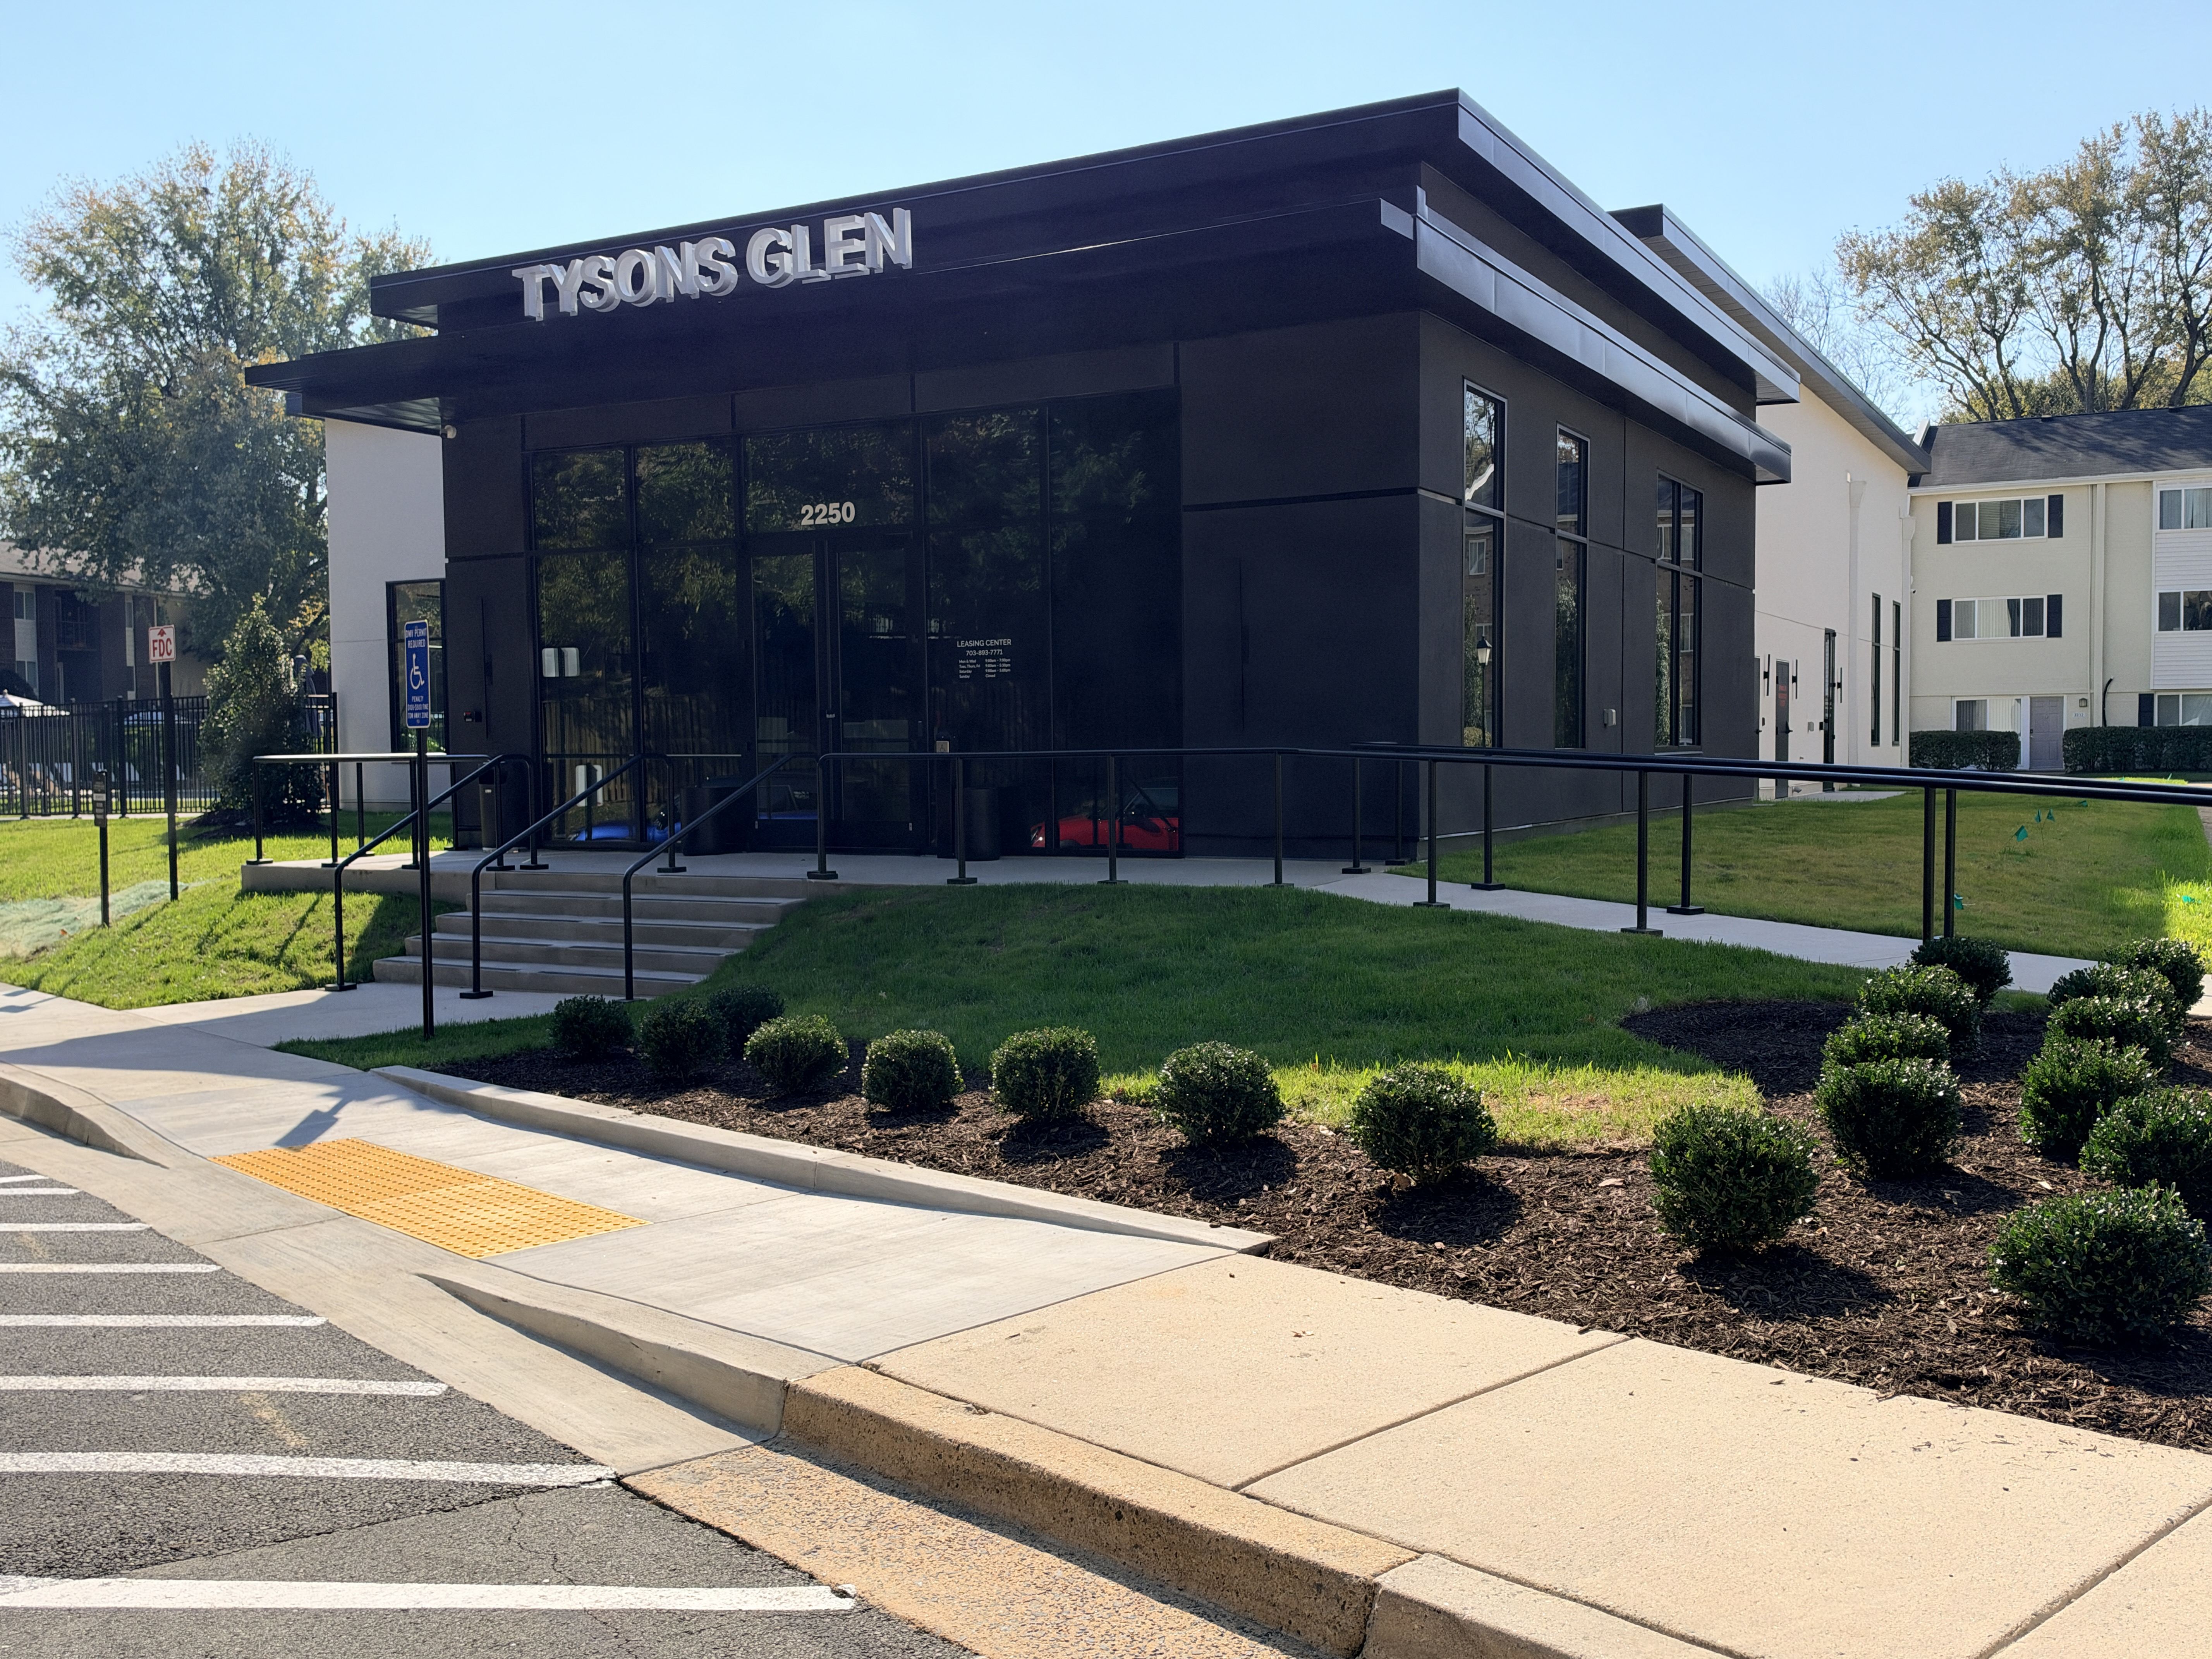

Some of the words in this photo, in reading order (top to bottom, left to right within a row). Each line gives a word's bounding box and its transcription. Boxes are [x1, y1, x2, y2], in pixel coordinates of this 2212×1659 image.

[512, 237, 738, 321] TYSONS
[746, 207, 912, 289] GLEN
[801, 501, 855, 526] 2250
[405, 629, 414, 638] DMV
[414, 627, 427, 637] PERMIT
[152, 637, 172, 657] FDC
[408, 639, 426, 648] REQUIRED
